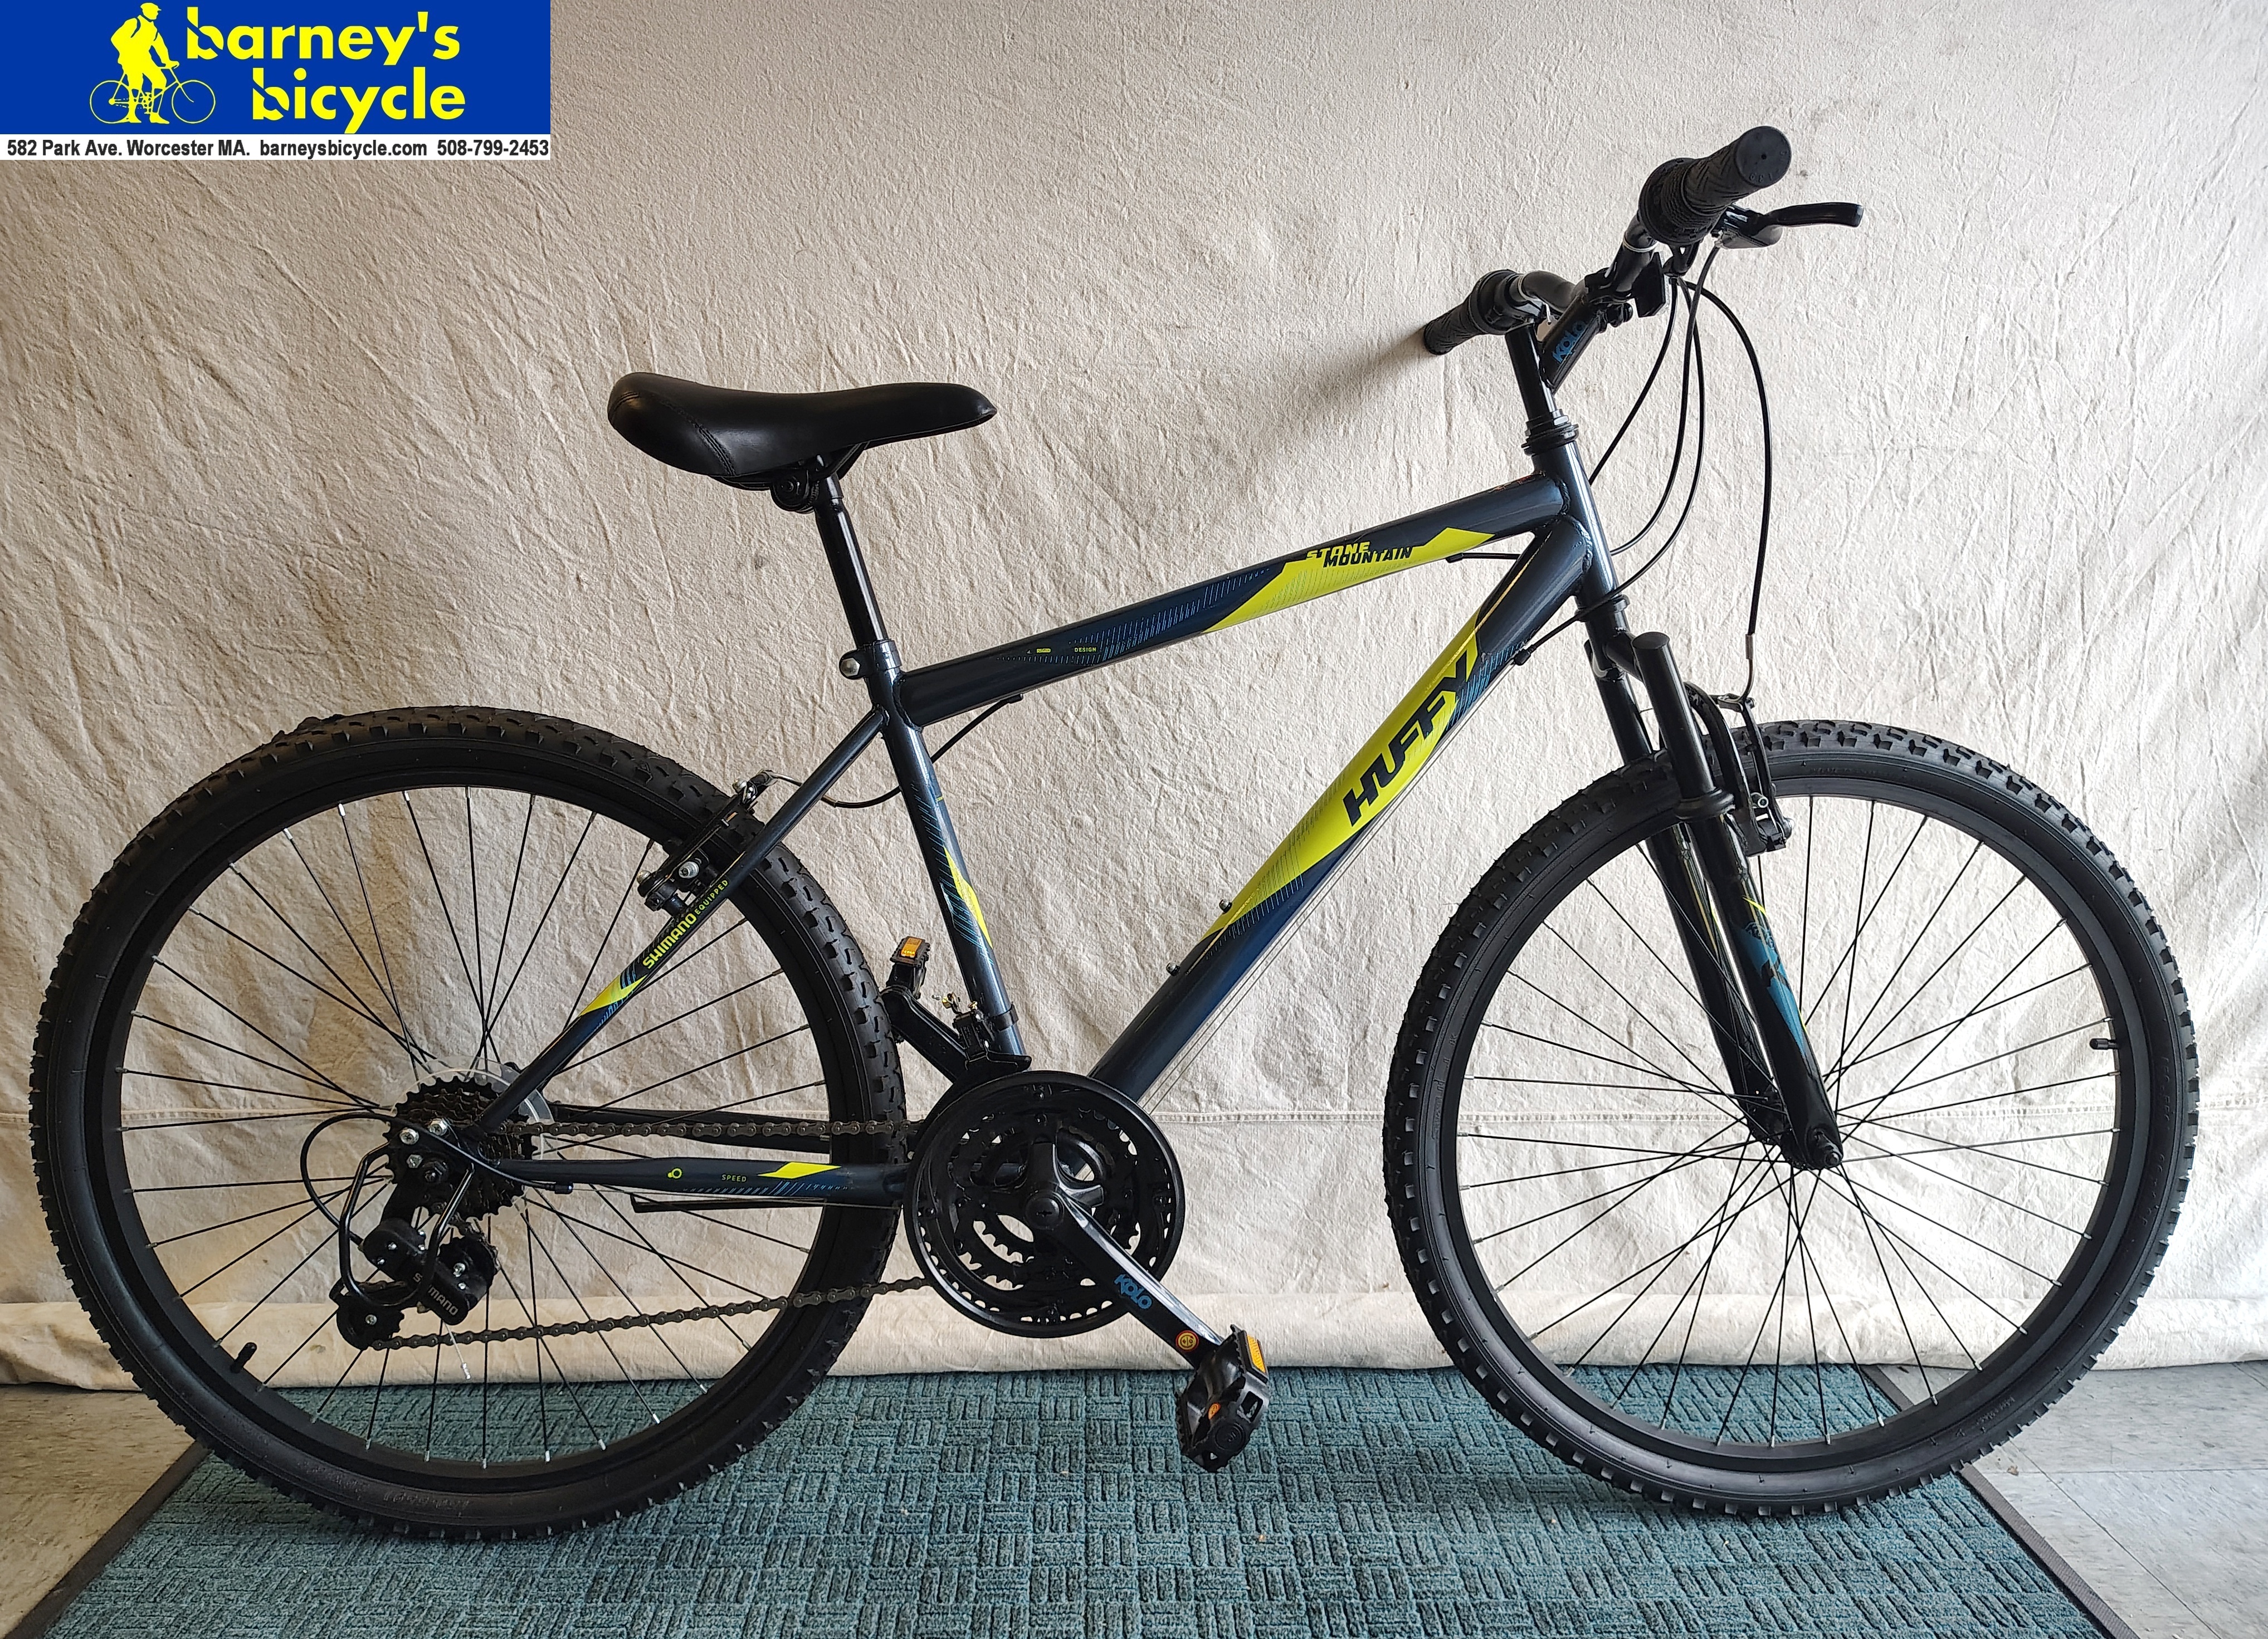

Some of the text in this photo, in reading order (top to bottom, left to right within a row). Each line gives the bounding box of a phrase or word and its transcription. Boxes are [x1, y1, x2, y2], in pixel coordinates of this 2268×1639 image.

[1551, 321, 1587, 363] KOLO
[1305, 541, 1370, 560] STONE
[1323, 546, 1413, 568] MOUNTAIN
[1342, 642, 1479, 827] HUFFY
[642, 880, 728, 969] SHIMANO EQUIPPED
[721, 1174, 747, 1182] SPEED
[412, 1272, 459, 1316] SMANO
[1114, 1274, 1153, 1310] KOLO
